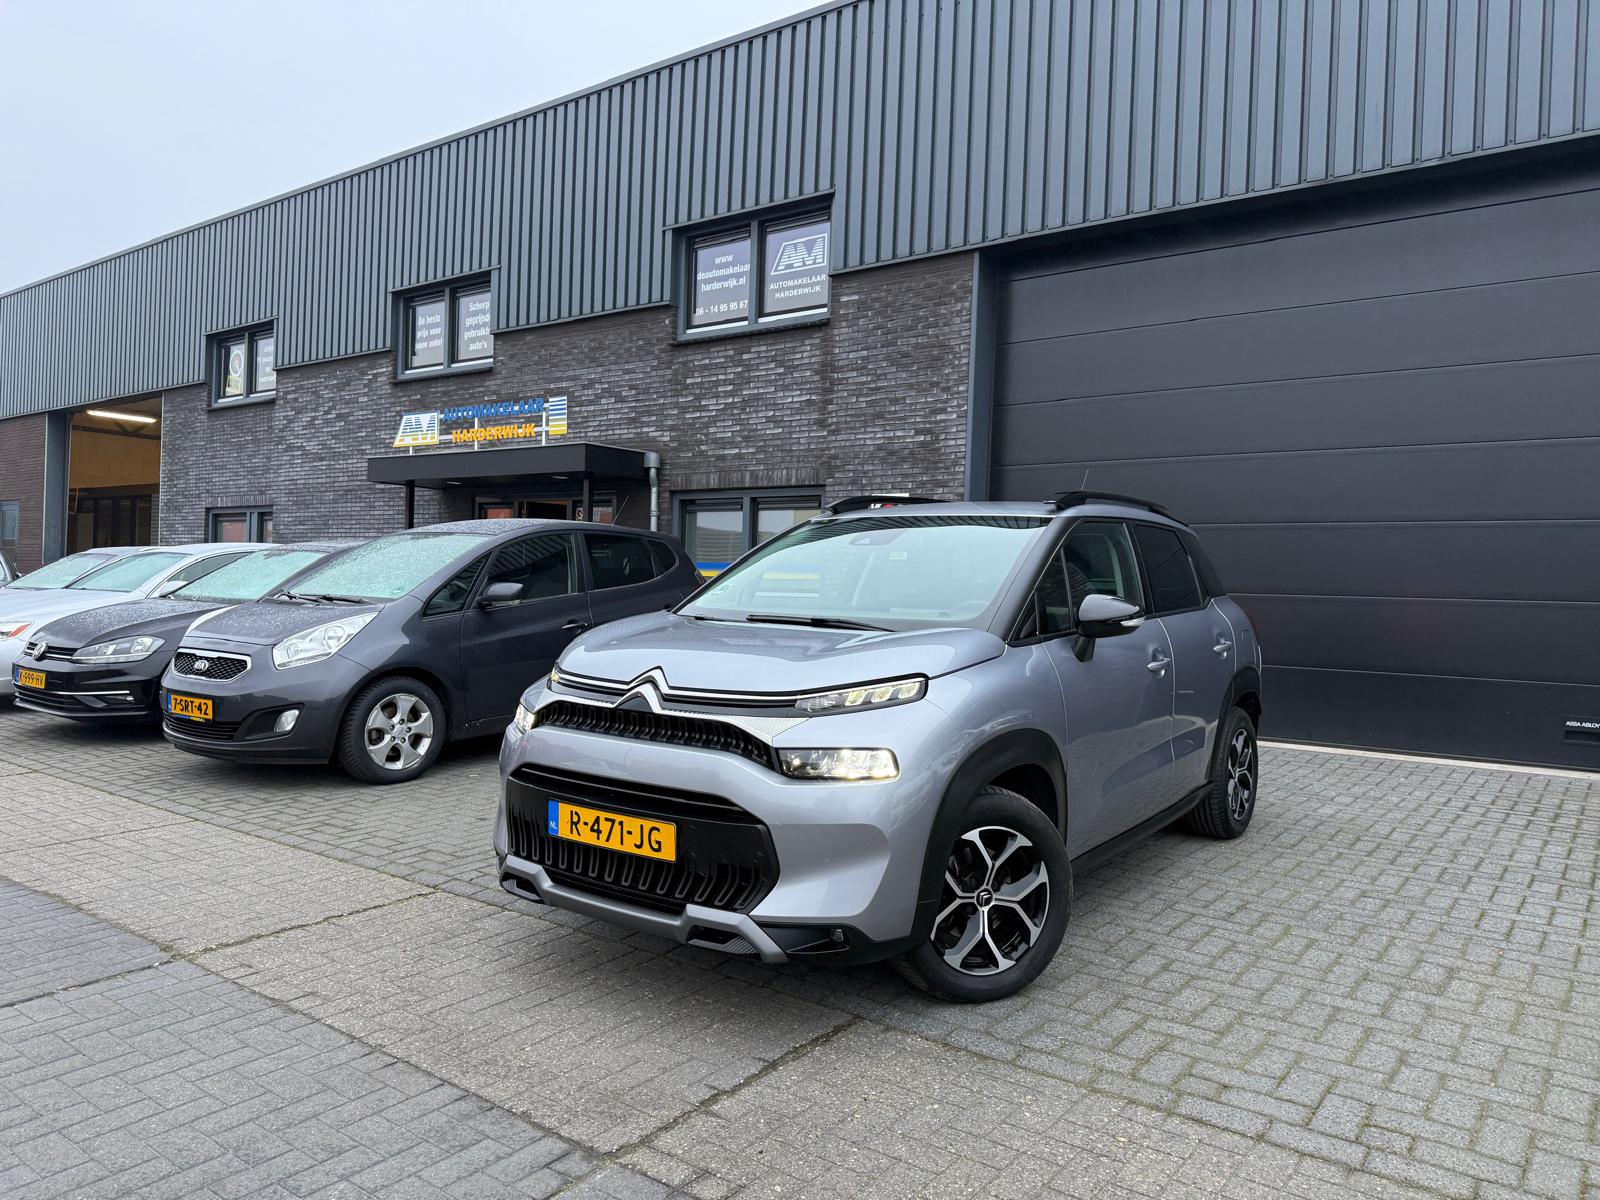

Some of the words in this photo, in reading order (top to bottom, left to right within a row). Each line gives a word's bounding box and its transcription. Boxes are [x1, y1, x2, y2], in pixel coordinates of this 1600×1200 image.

[714, 254, 733, 264] www
[697, 263, 750, 280] deautomakelaar
[701, 276, 746, 292] harderwijk.nl
[769, 274, 826, 290] AUTOMAKELAAR
[774, 285, 822, 299] HARDERWIJK
[469, 301, 490, 312] Scherp
[695, 307, 704, 316] 06
[710, 305, 718, 314] 14
[719, 303, 728, 312] 95
[729, 301, 738, 311] 95
[426, 314, 441, 324] beste
[430, 327, 442, 336] voor
[469, 340, 488, 351] auto's
[443, 398, 545, 421] AUTOMAKELAAR
[452, 423, 536, 443] HARDERWIJK
[173, 697, 209, 716] 7-SRT-42
[549, 821, 558, 830] NL
[569, 809, 662, 853] R-471-JG
